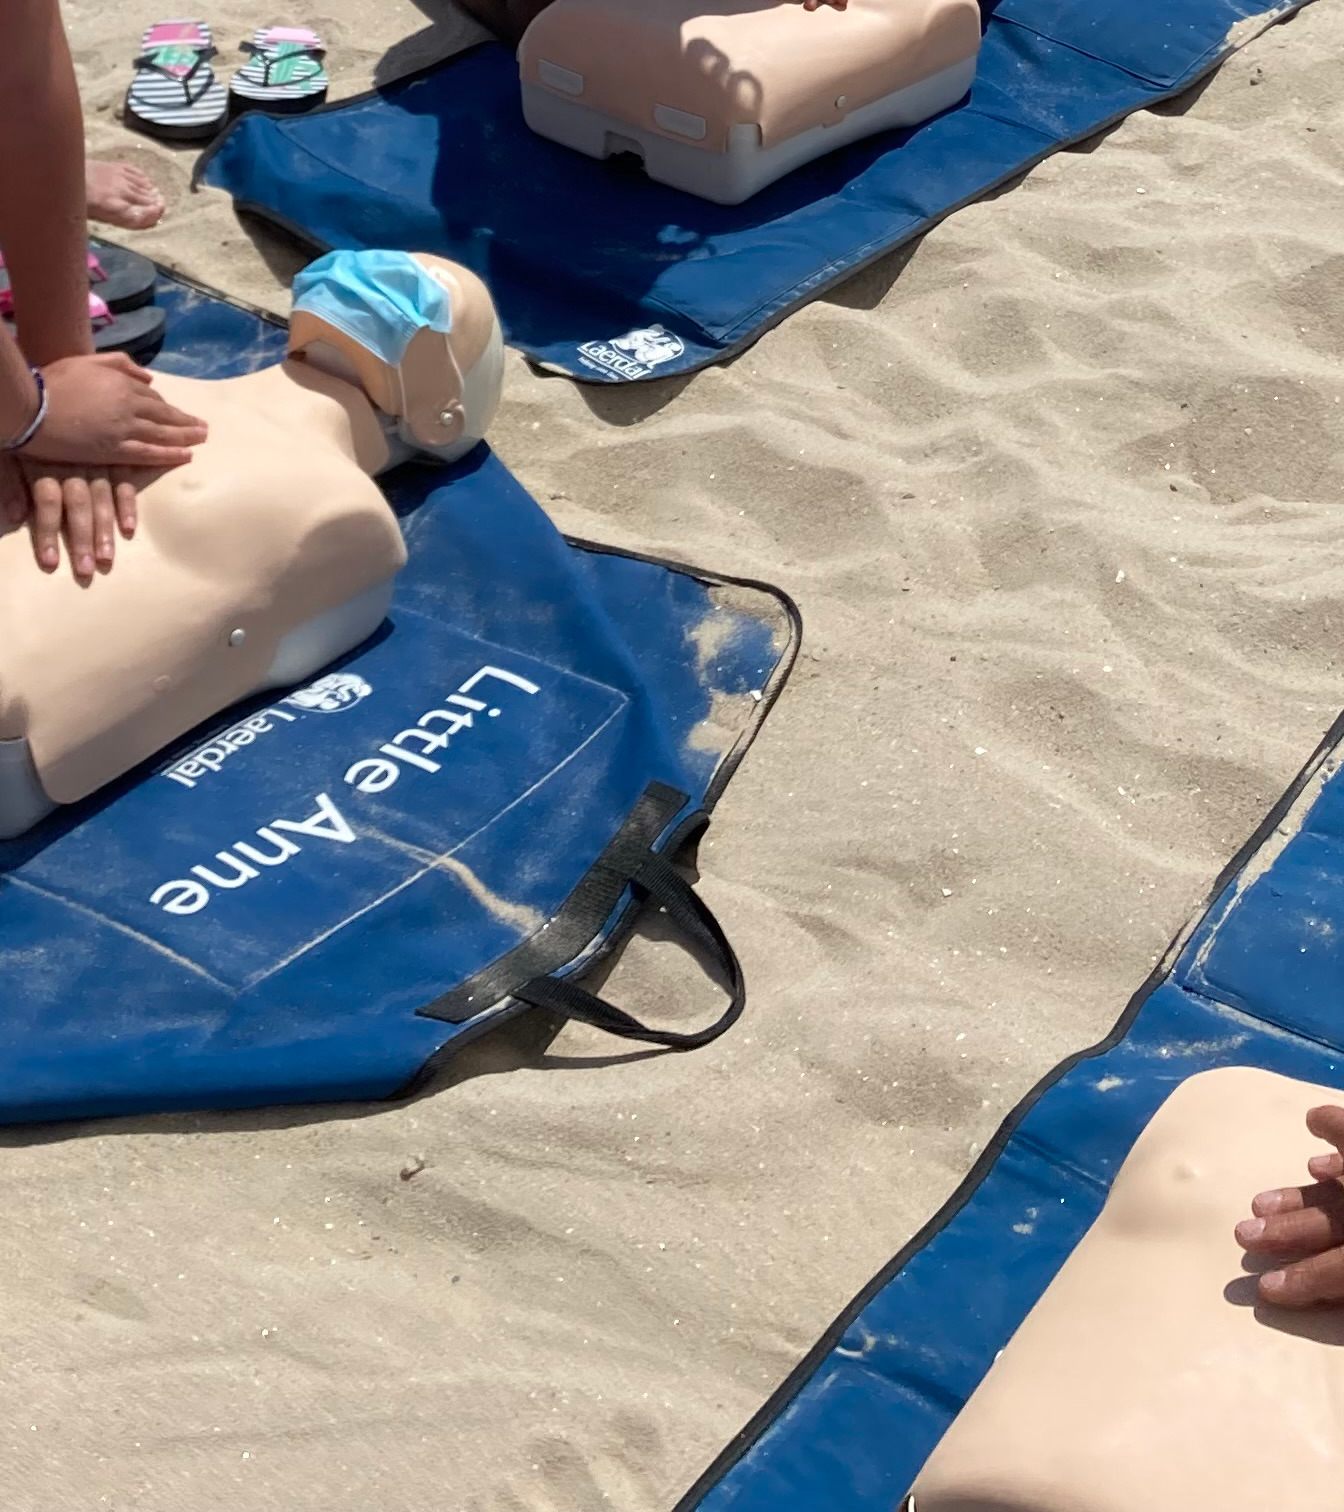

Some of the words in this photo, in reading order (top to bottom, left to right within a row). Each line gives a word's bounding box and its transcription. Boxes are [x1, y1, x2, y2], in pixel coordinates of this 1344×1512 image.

[580, 340, 652, 380] Laerdal
[164, 707, 297, 790] Laerdal
[343, 664, 541, 794] Little
[149, 792, 357, 916] Anne
